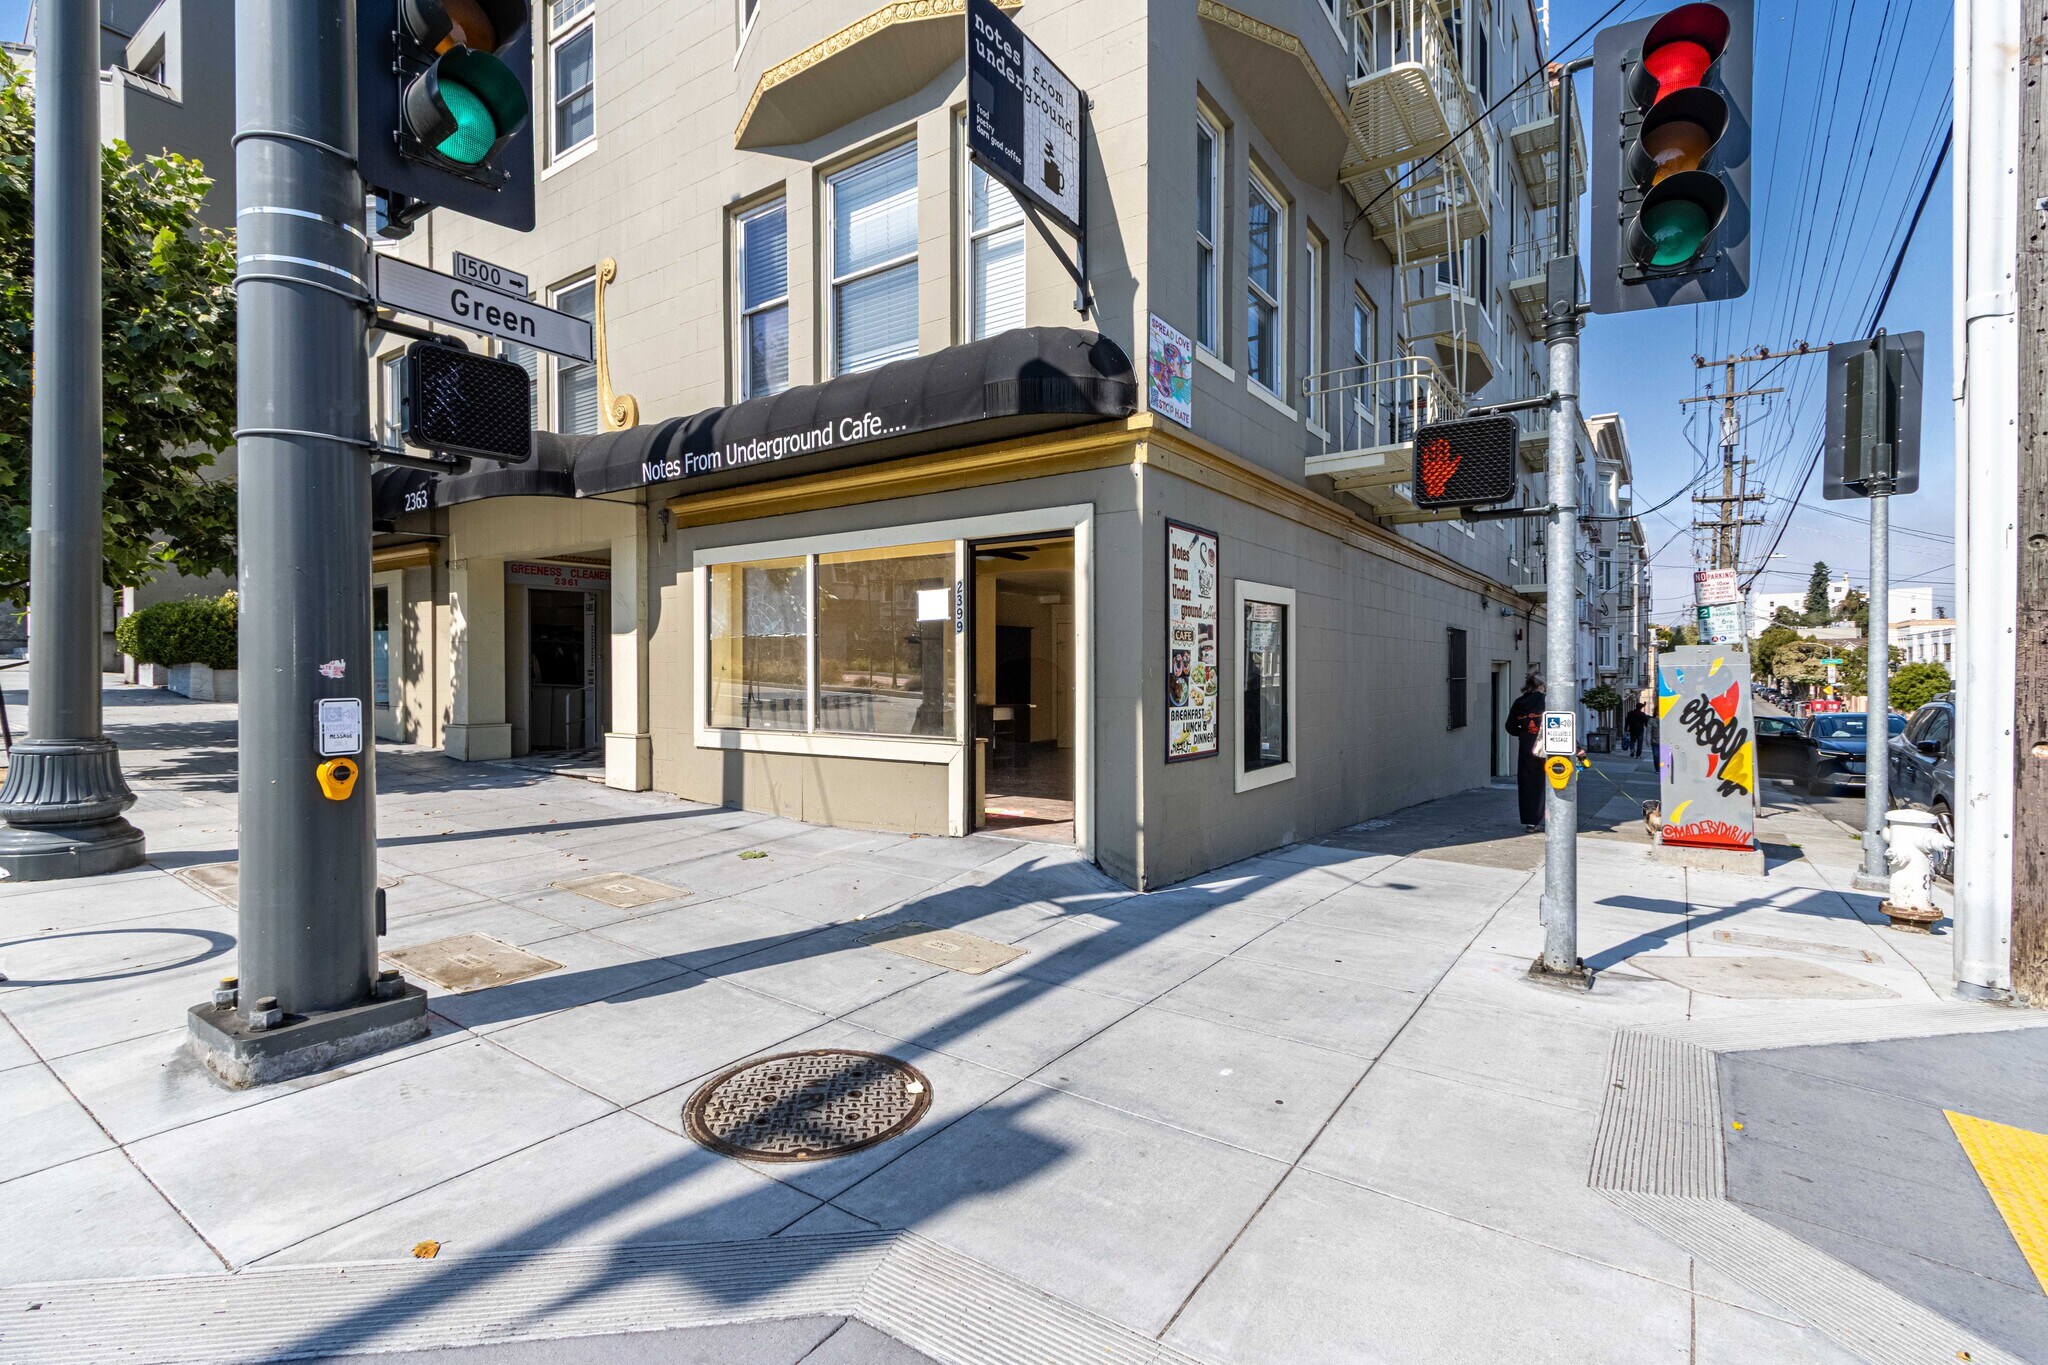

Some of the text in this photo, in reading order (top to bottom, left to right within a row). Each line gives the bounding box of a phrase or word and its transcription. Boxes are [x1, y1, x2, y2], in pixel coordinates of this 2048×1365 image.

[975, 14, 1064, 107] notes from
[977, 103, 990, 120] food
[977, 114, 994, 135] poetry
[977, 124, 1021, 165] darn good coffee
[462, 258, 501, 285] 1500
[451, 288, 536, 338] Green
[1152, 318, 1190, 352] SPREAD LOVE
[1159, 399, 1189, 424] STOP HATE
[642, 458, 680, 482] Notes
[684, 452, 721, 474] From
[726, 421, 833, 463] Underground
[405, 490, 428, 512] 2363
[1172, 543, 1189, 562] Notes
[511, 564, 562, 577] GREENESS
[1174, 564, 1188, 581] from
[1695, 572, 1733, 581] NO PARKING
[554, 578, 578, 586] 2361
[1172, 584, 1191, 601] Under
[1181, 604, 1202, 620] ground
[1700, 609, 1708, 617] 2
[1175, 632, 1192, 640] CAFE
[1171, 709, 1204, 721] BREAKFAST
[1183, 721, 1201, 733] LUNCH
[1194, 732, 1214, 745] DINNER
